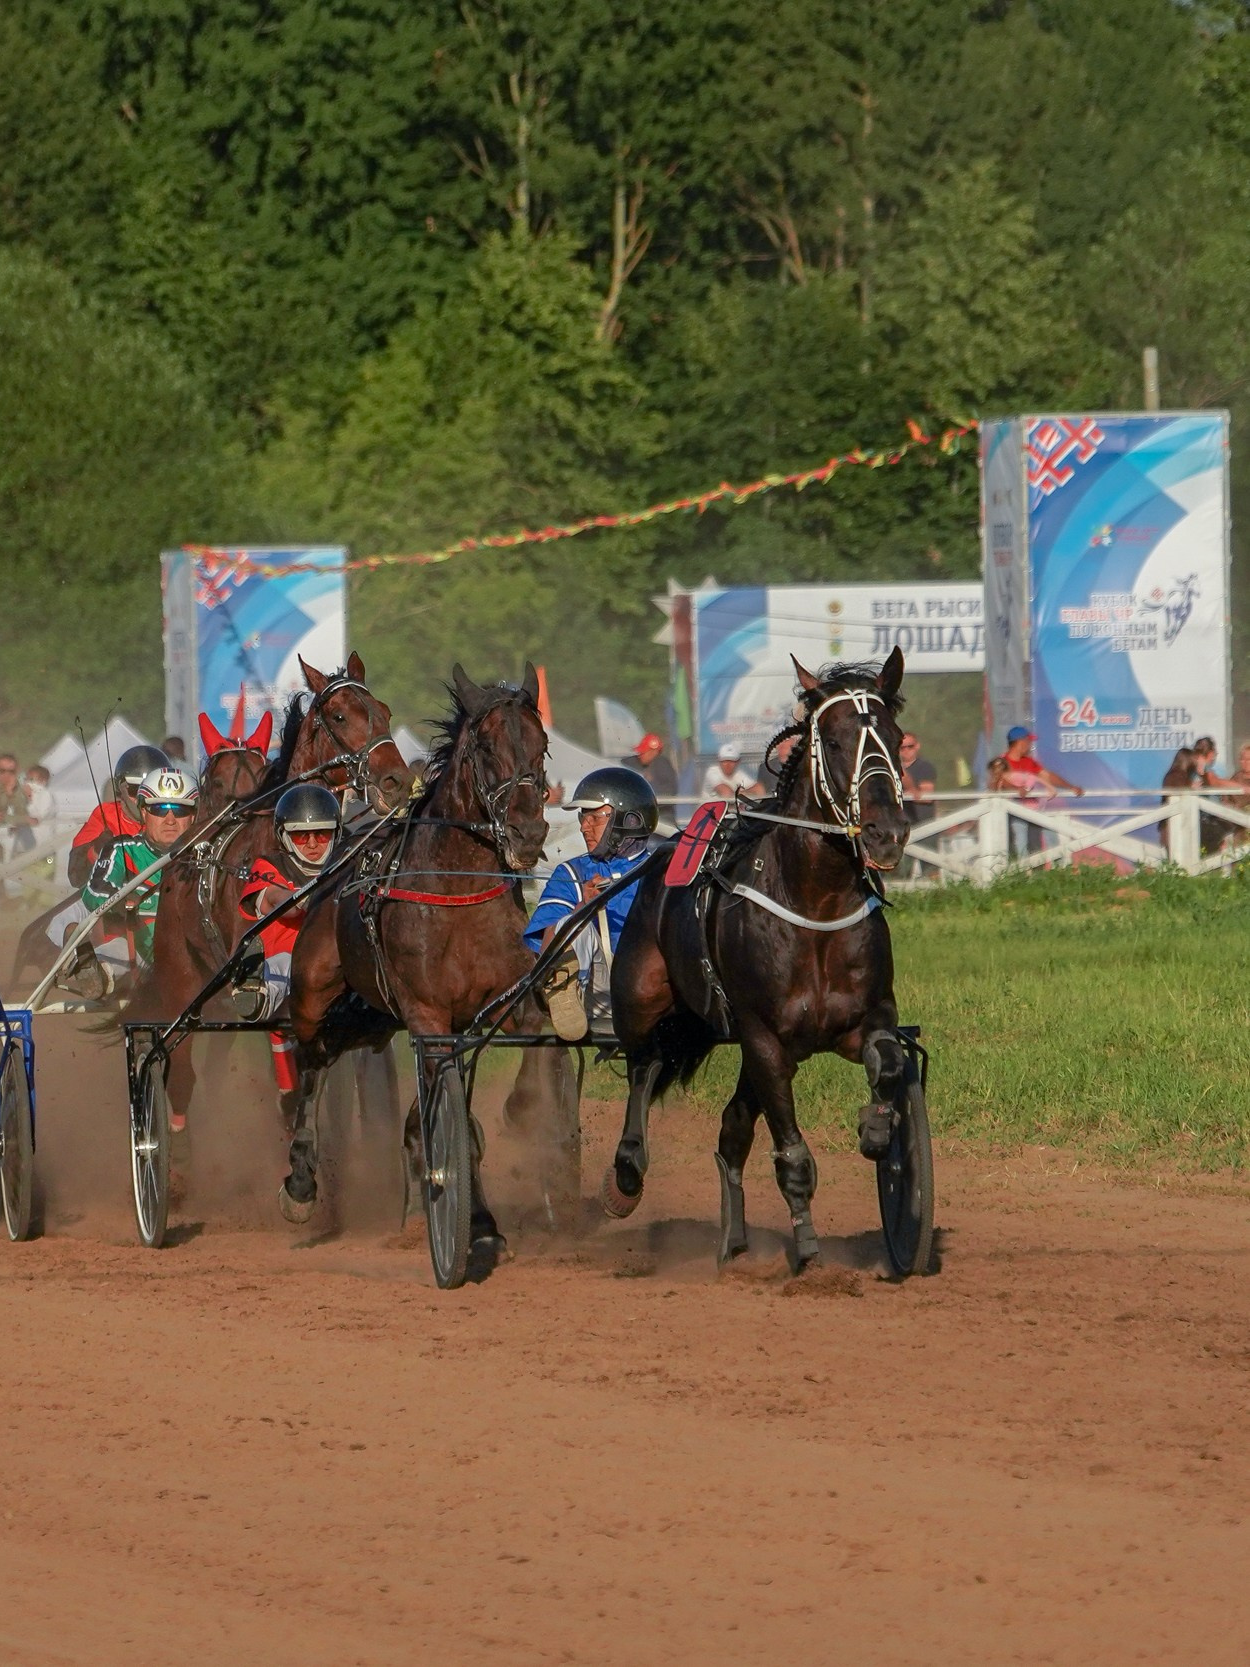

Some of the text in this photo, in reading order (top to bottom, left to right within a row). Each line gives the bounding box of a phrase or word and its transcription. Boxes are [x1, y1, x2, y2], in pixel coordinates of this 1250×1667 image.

[871, 600, 919, 619] БЕГА
[1061, 608, 1134, 622] ГЛАВЫ ЧР
[1070, 623, 1158, 637] ПО КОННЫМ
[1113, 638, 1158, 651] БЕГАМ
[1061, 699, 1096, 725] 24
[1139, 708, 1192, 726] ДЕНЬ
